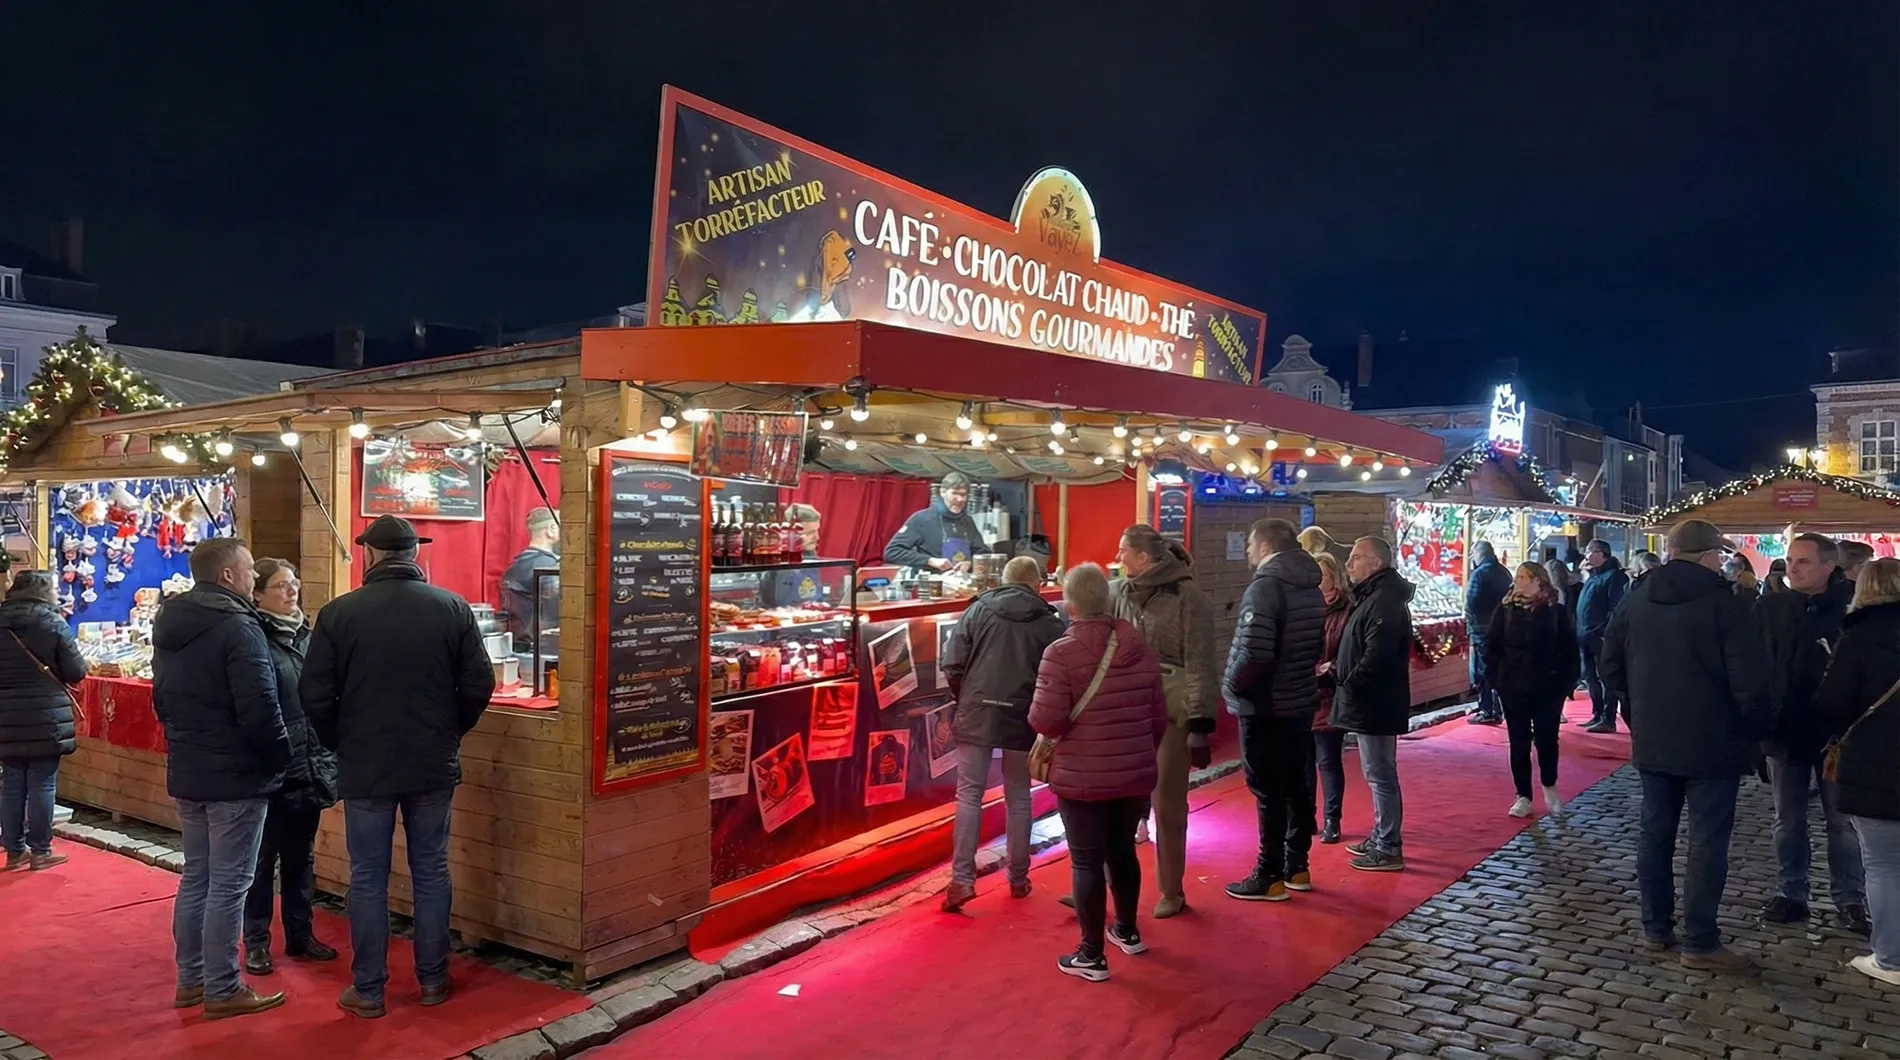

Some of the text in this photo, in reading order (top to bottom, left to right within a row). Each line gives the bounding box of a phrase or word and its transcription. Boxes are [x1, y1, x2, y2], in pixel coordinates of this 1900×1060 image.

[675, 180, 826, 244] TORRÉFACTEUR
[707, 159, 792, 205] ARTISAN
[854, 200, 1196, 340] CAFÉ CHOCOLAT CHAUD THÉ
[886, 267, 1176, 372] BOISSONS GOURMANDES
